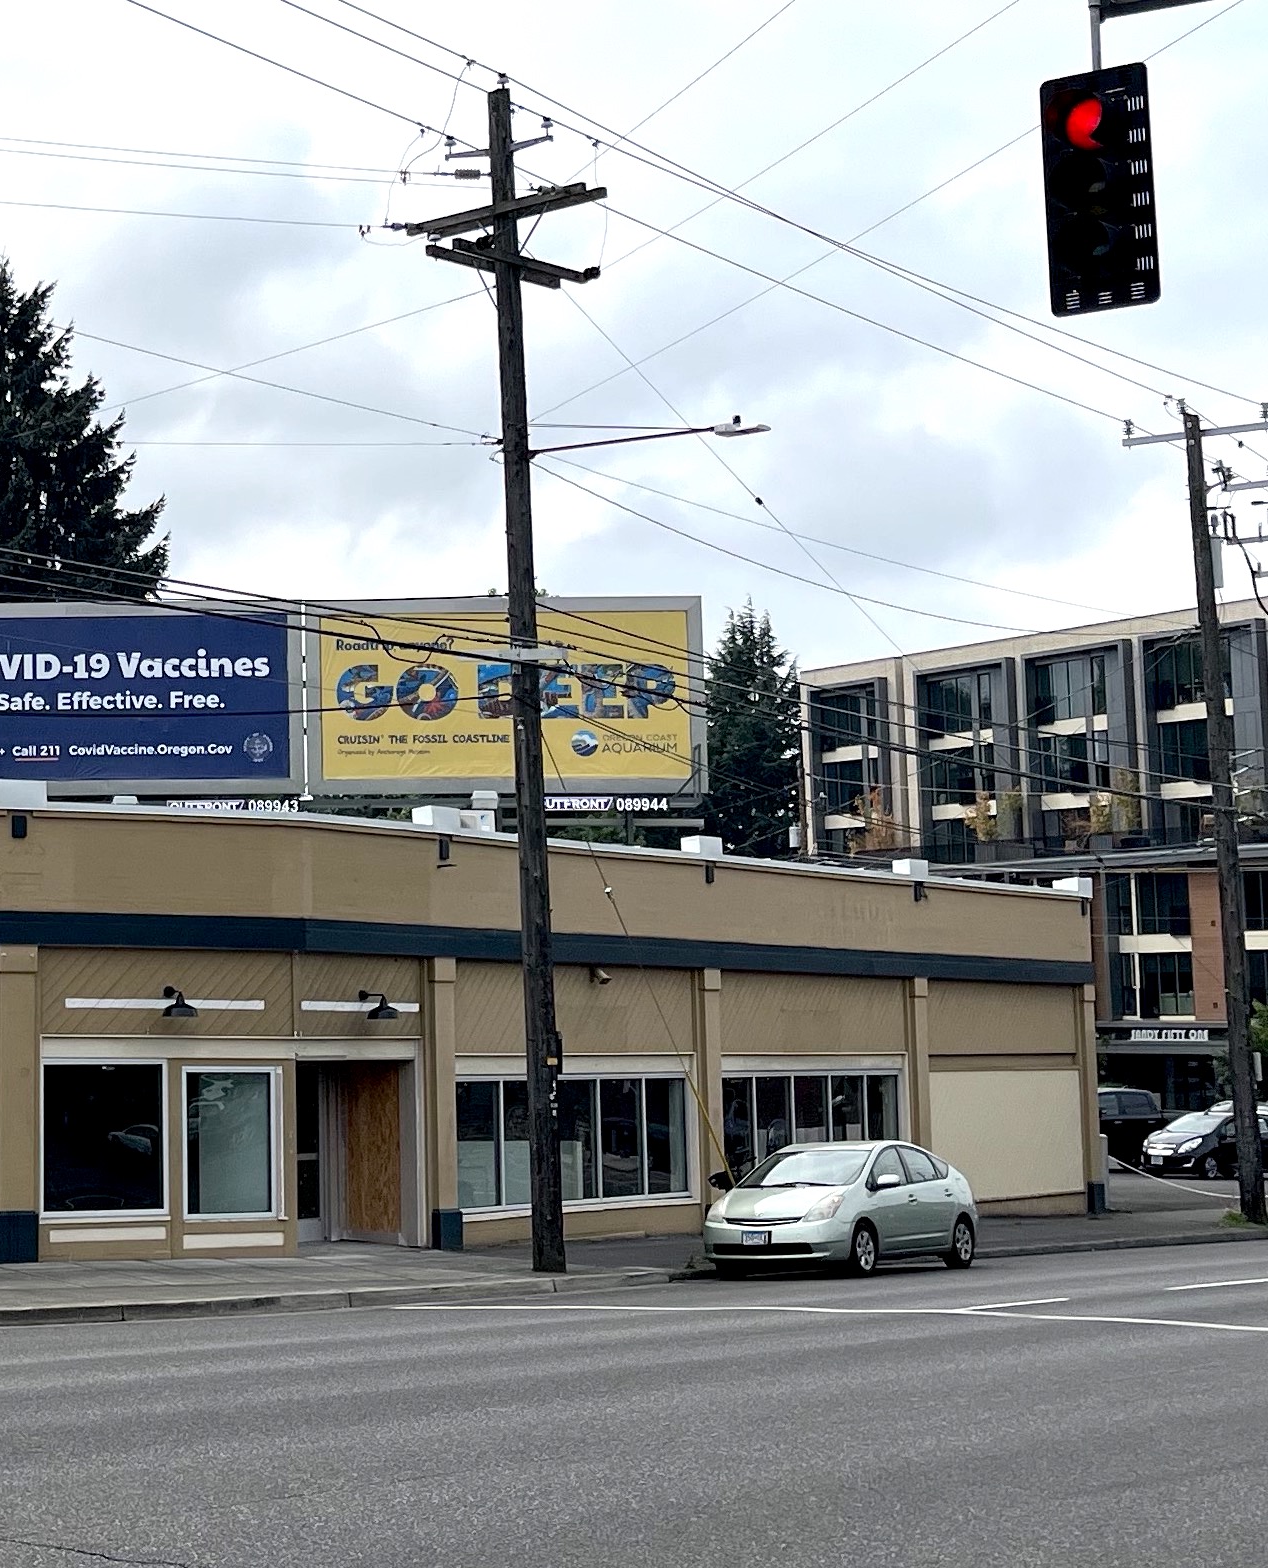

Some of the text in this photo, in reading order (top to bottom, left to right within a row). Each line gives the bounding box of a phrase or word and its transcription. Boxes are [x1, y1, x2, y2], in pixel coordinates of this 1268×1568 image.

[117, 648, 270, 678] Vaccines
[336, 663, 675, 721] GO DEEP
[57, 690, 163, 710] Effective.
[169, 691, 225, 709] Free.
[337, 734, 510, 744] CRUISIN' THE FOSSIL COASTLINE
[12, 745, 36, 757] Call
[40, 745, 60, 756] 211
[248, 799, 299, 812] 089943
[616, 798, 668, 811] 089944
